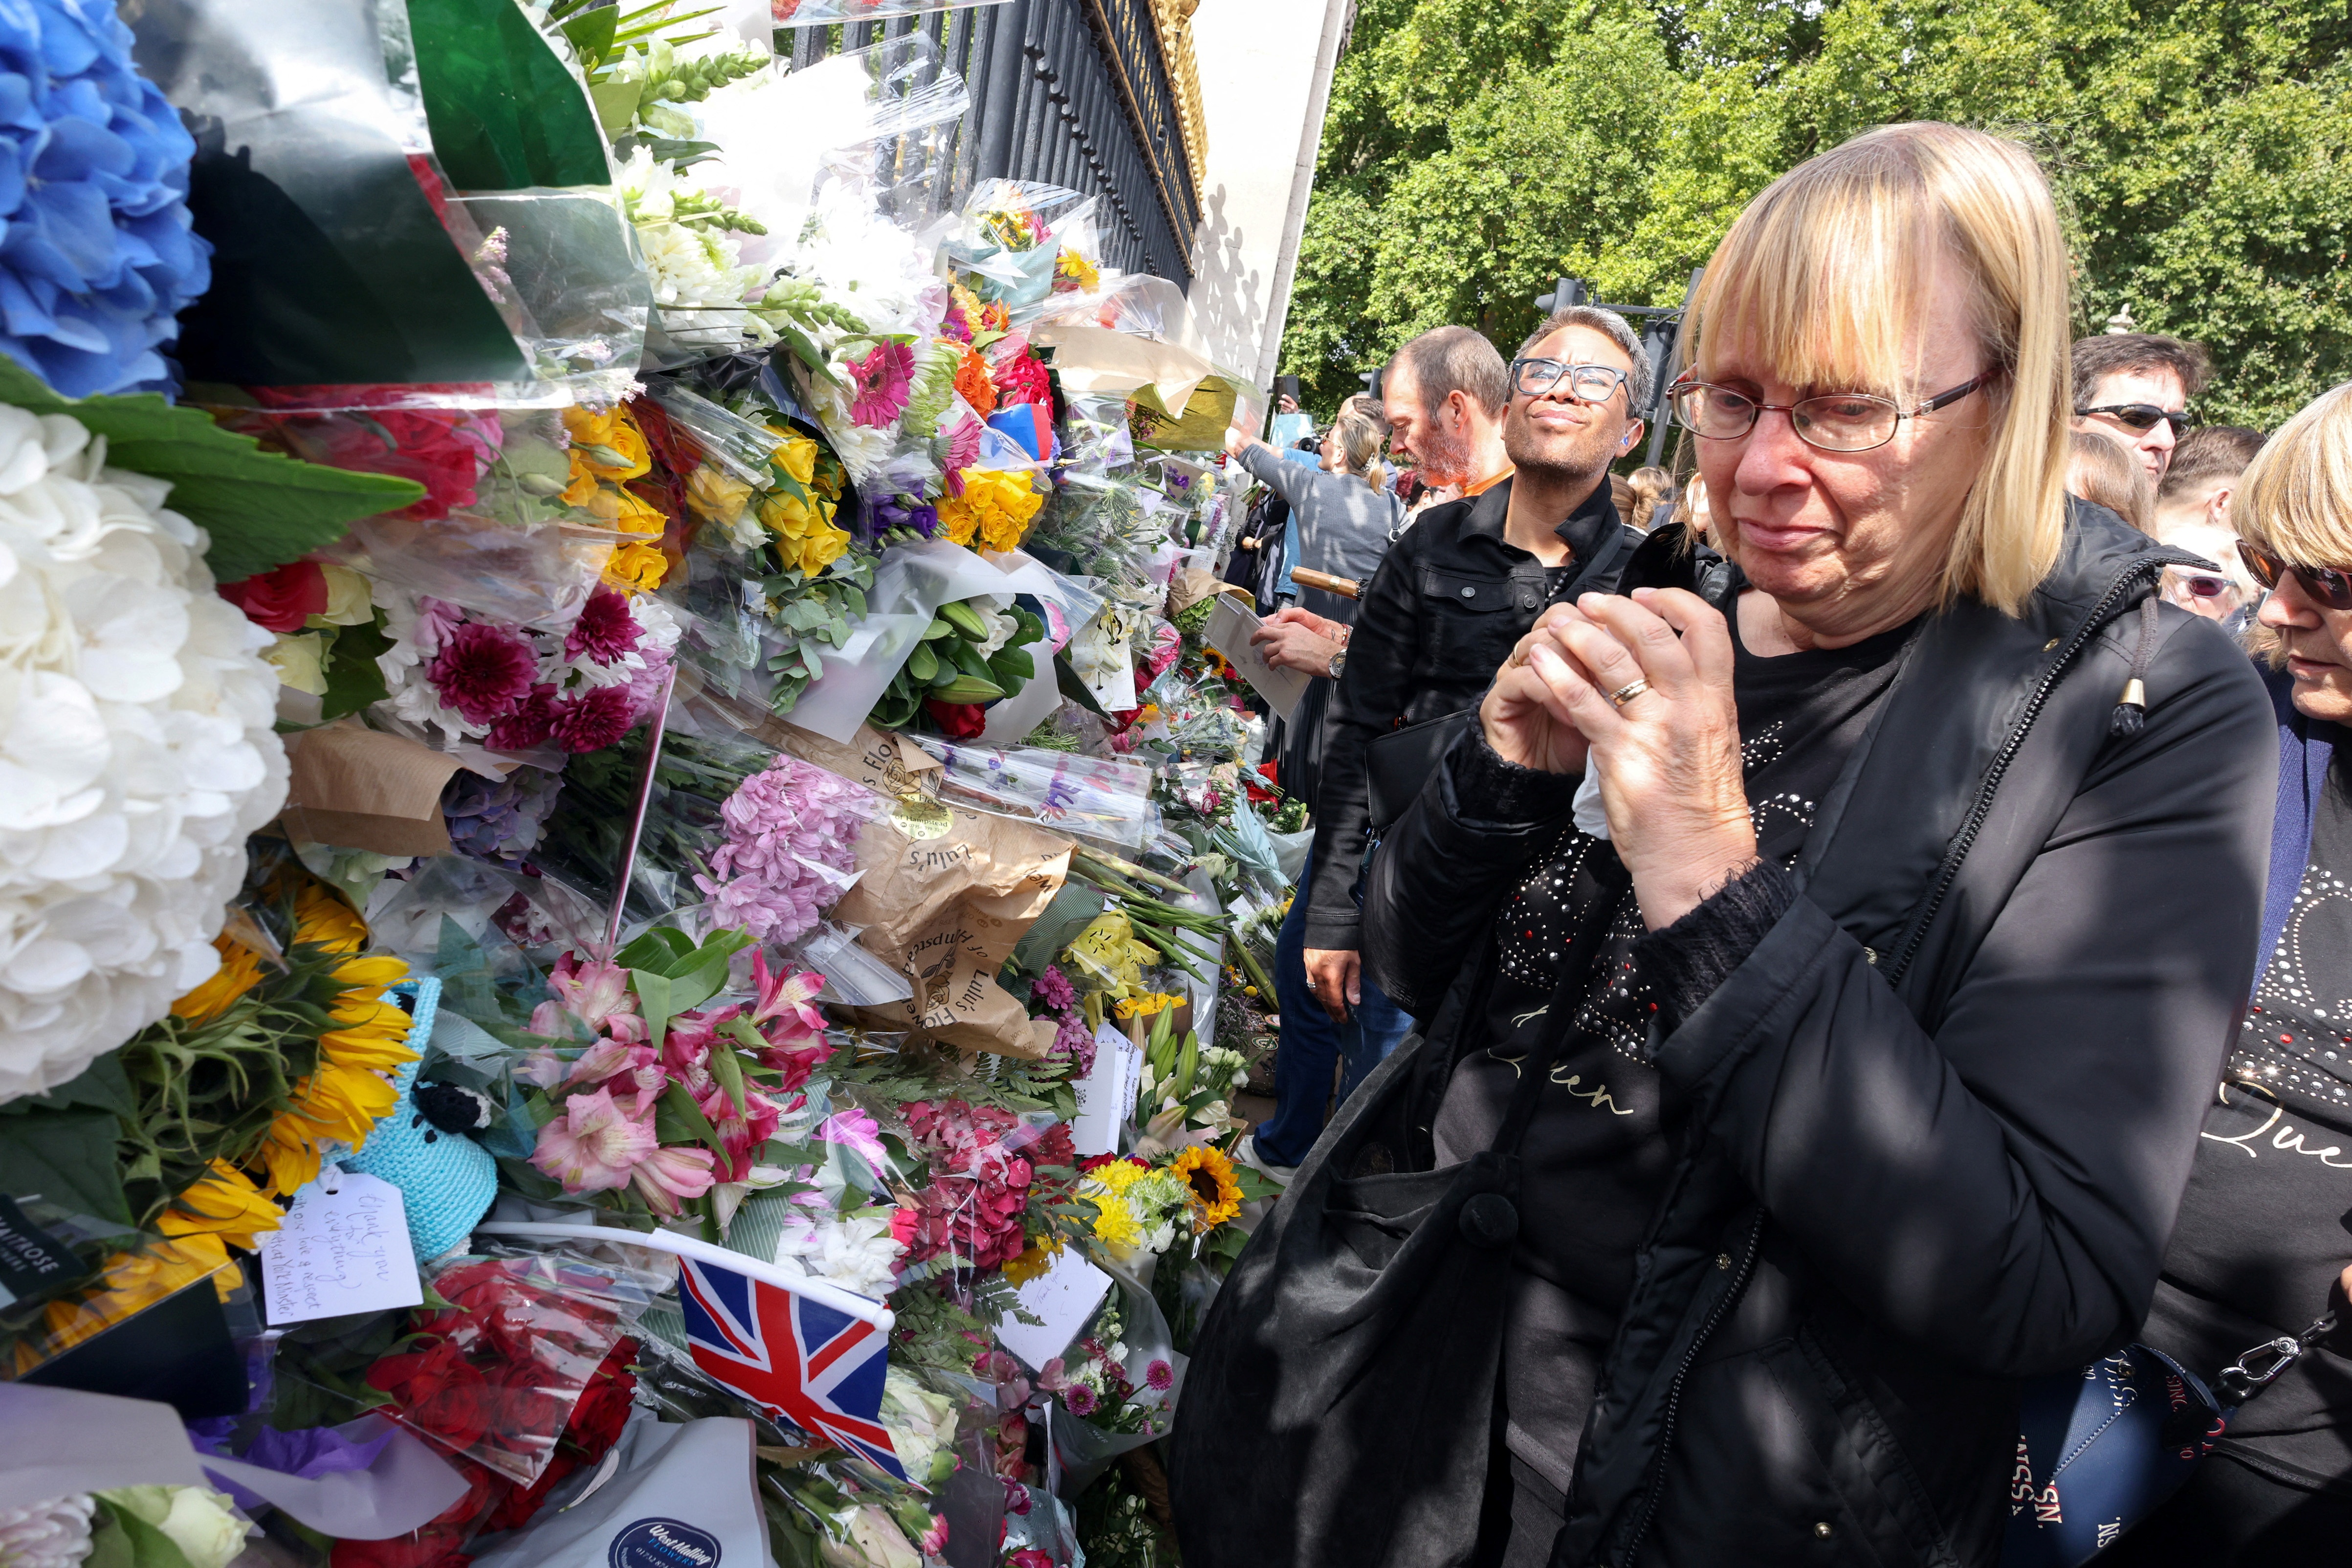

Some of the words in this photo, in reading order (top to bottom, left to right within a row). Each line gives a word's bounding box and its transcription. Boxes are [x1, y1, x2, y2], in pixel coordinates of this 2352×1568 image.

[919, 794, 949, 817] Flowers
[906, 816, 948, 828] Hampstead
[909, 844, 972, 871] Lulu's
[901, 928, 974, 977] Hmpstead
[967, 946, 989, 958] of
[955, 969, 989, 1012] Lulu's
[899, 998, 959, 1030] Flower
[298, 1237, 313, 1256] love
[272, 1259, 294, 1281] York
[274, 1281, 298, 1317] Minster
[294, 1272, 322, 1310] respect
[648, 1537, 696, 1567] FLOWERS
[649, 1524, 678, 1547] West
[671, 1541, 712, 1566] Malling
